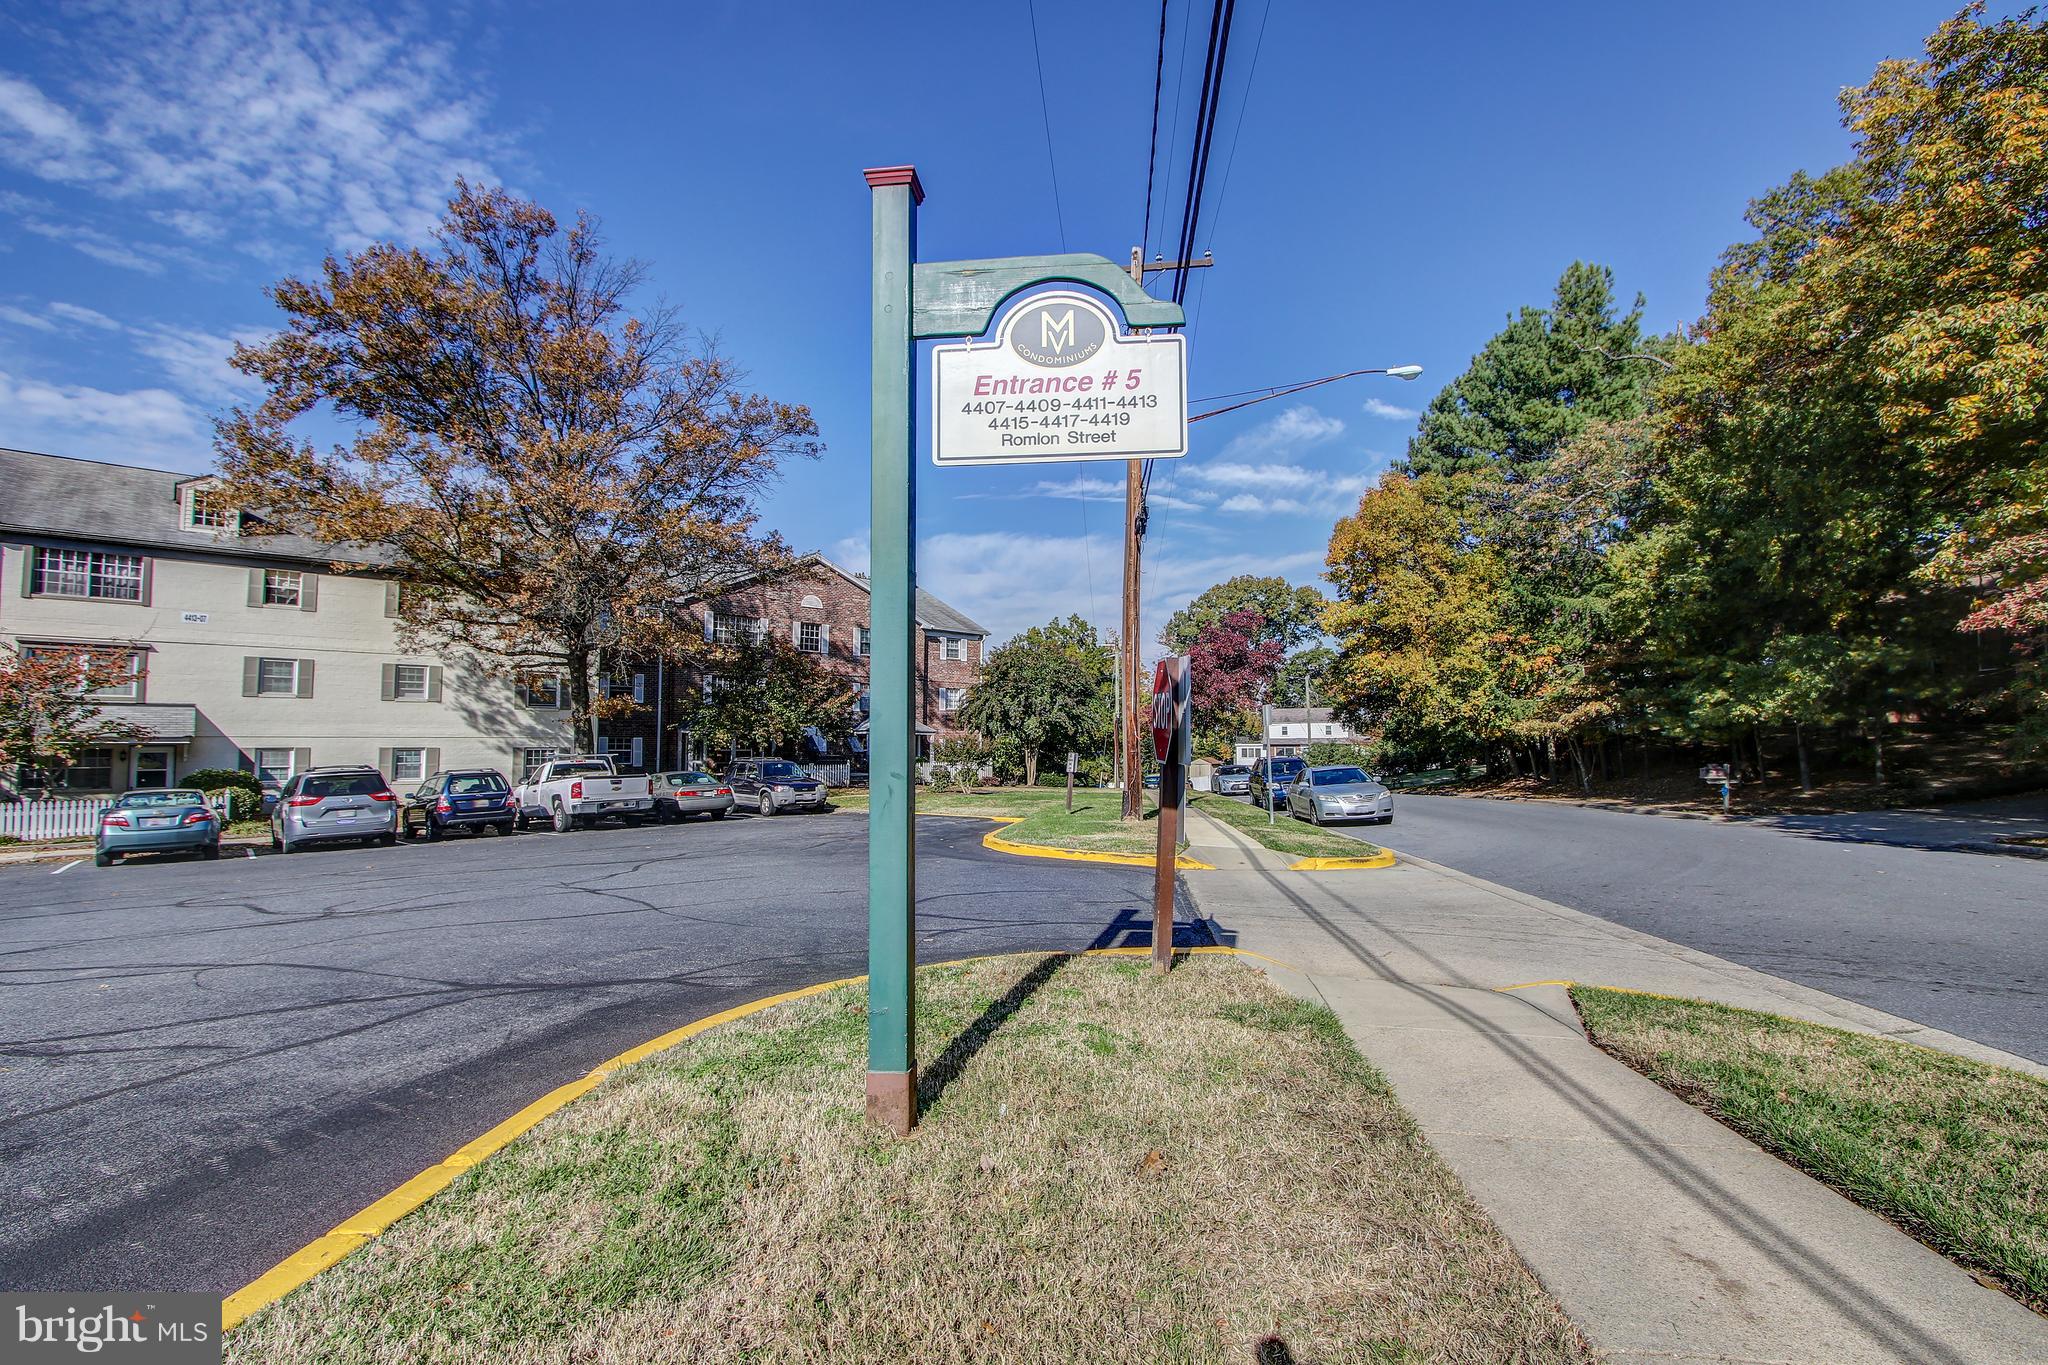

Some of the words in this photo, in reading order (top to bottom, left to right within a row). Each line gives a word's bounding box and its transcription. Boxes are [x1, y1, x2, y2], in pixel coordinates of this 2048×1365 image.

[1017, 342, 1097, 364] CONDOMINIUMS
[973, 374, 1094, 396] Entrance
[1125, 368, 1142, 391] 5
[961, 394, 1158, 415] 4407-4409-4411-4413
[988, 412, 1131, 430] 4415-4417-4419
[1001, 432, 1060, 447] Romlon
[1067, 430, 1117, 445] Street
[1153, 692, 1170, 729] STOP
